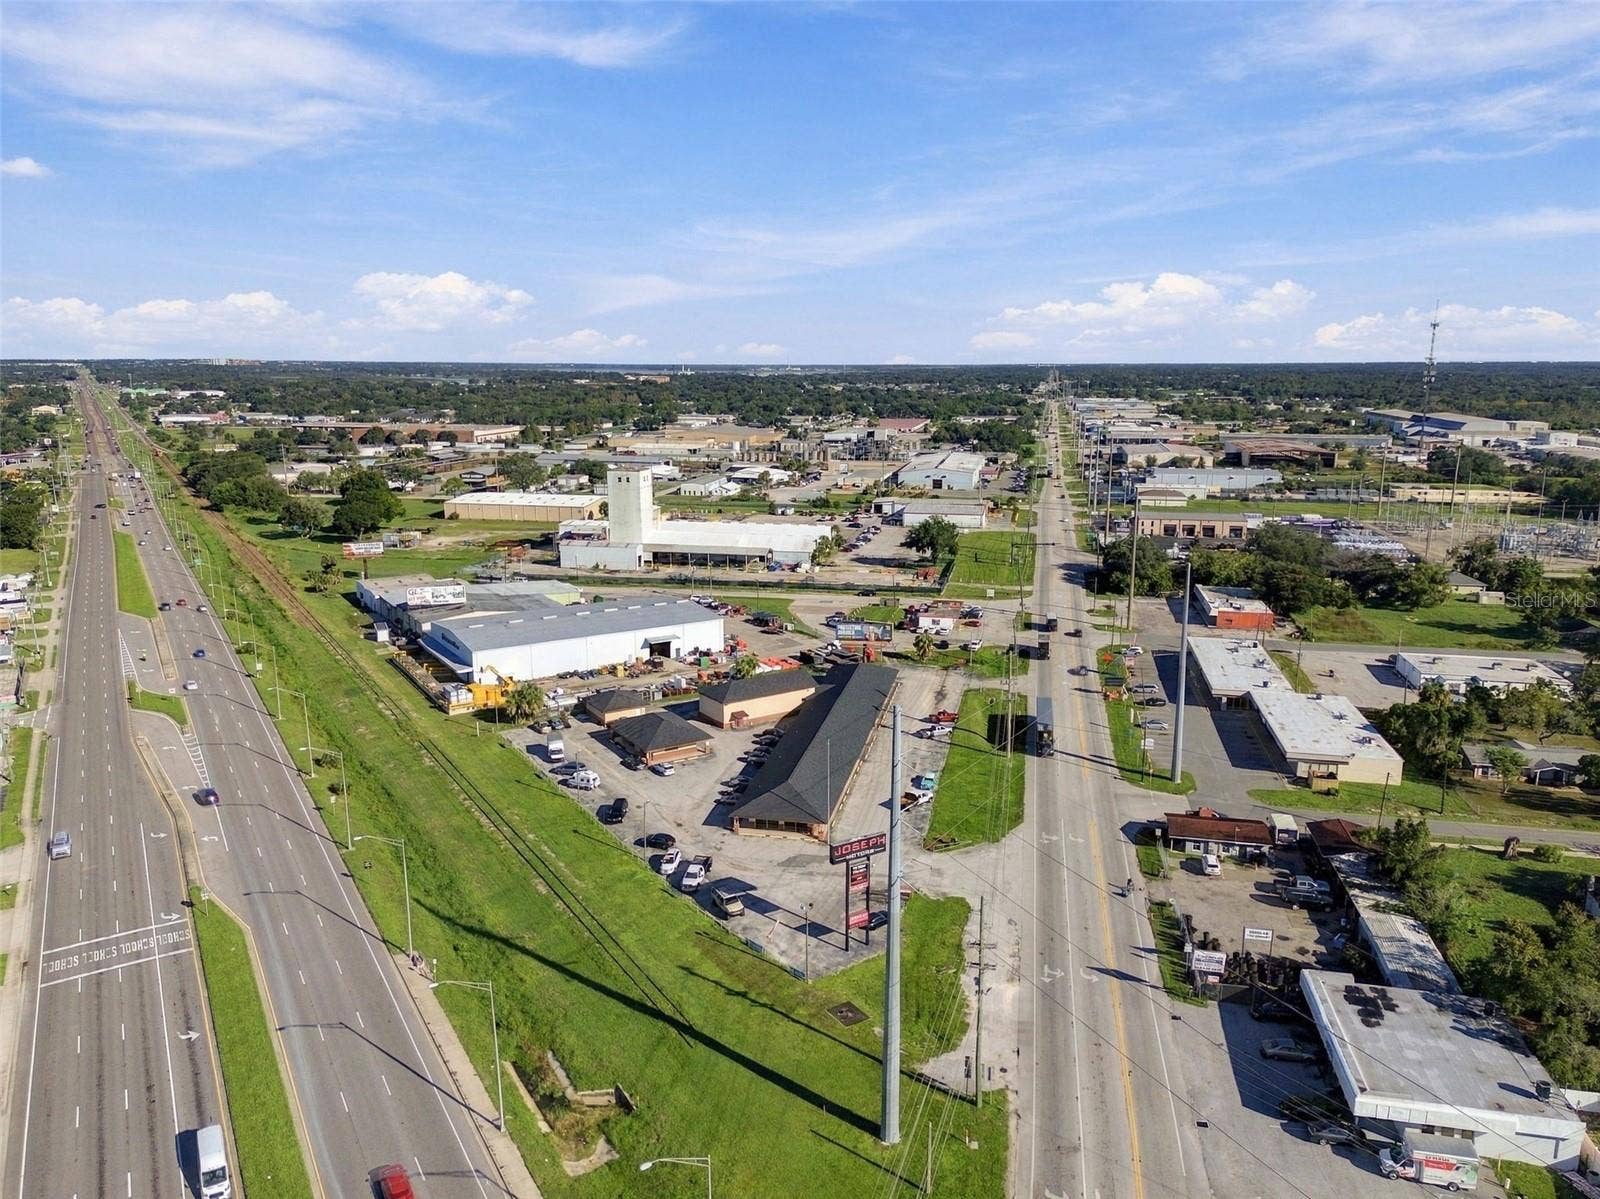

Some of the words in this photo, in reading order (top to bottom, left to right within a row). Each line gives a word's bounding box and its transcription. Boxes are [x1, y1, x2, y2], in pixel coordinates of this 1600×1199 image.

[834, 835, 886, 856] JOSEPH
[155, 928, 191, 946] SCHOOL
[82, 946, 118, 964] SCHOOL
[119, 938, 155, 955] SCHOOL
[42, 955, 79, 974] SCHOOL
